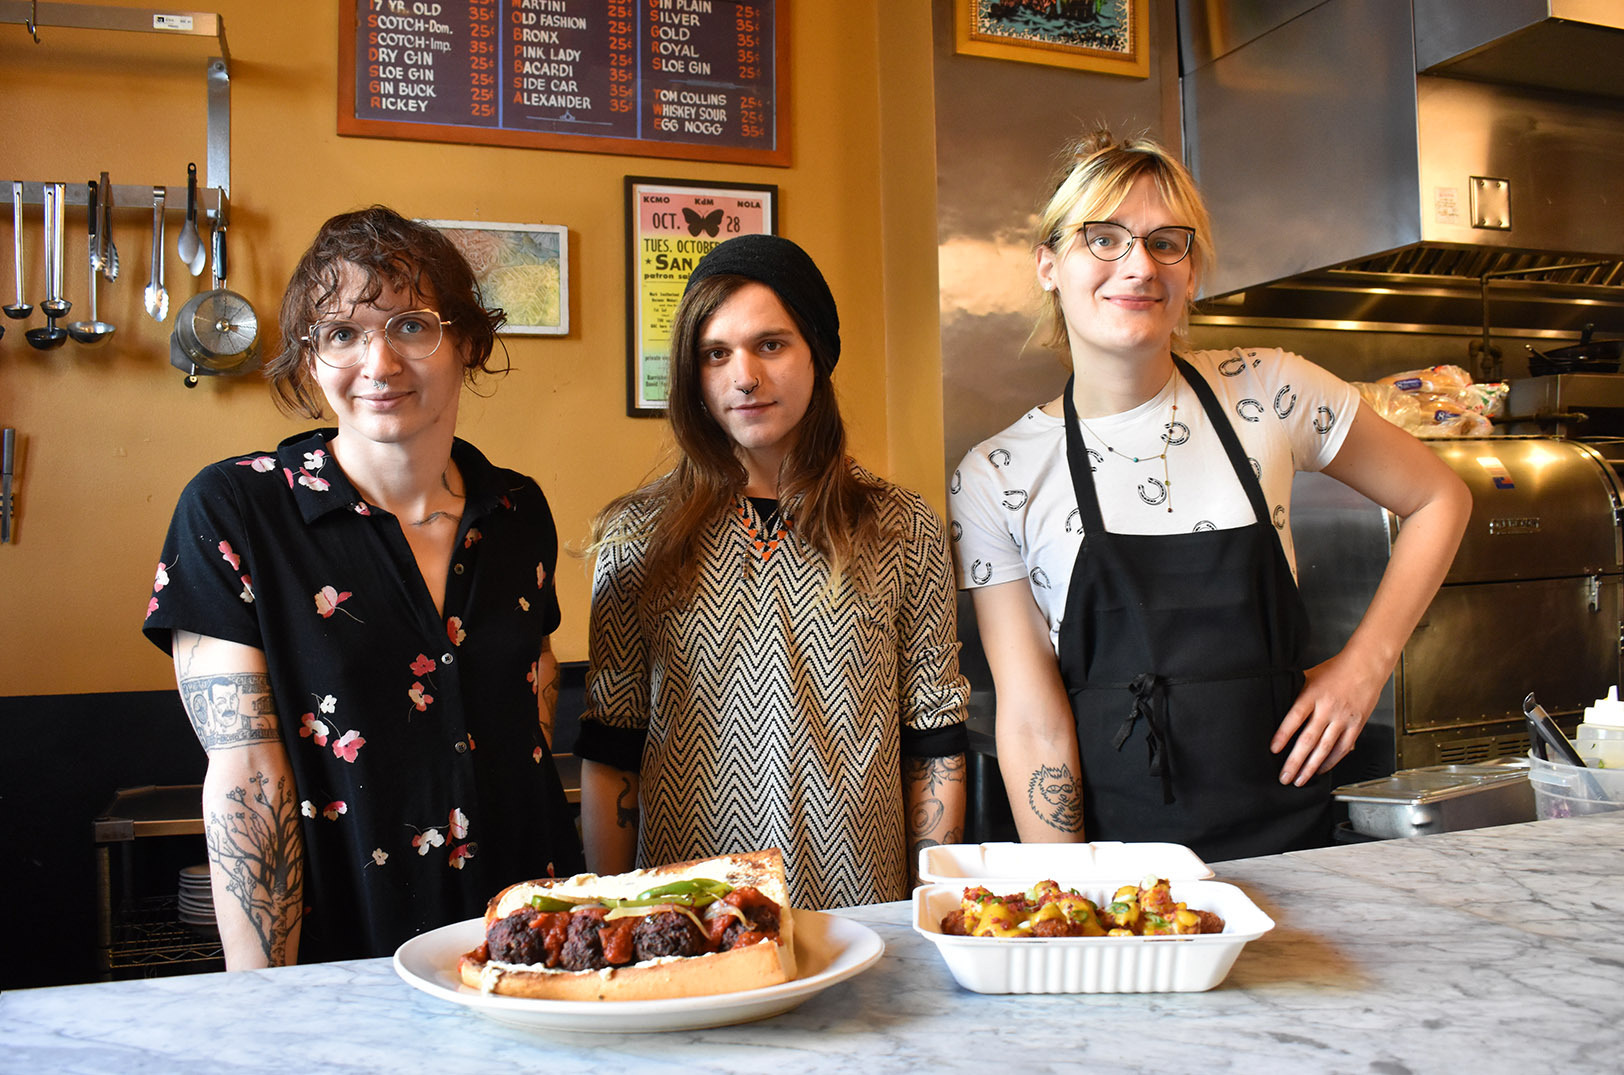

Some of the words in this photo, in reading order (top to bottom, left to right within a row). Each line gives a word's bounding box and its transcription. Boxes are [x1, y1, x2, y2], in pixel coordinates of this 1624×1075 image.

[413, 2, 442, 16] OLD
[511, 0, 566, 12] MARTINI
[677, 0, 712, 14] PLAIN
[511, 10, 536, 25] OLD
[540, 14, 587, 30] FASHION
[650, 9, 700, 27] SILVER
[513, 27, 559, 44] BRONX
[650, 25, 690, 41] GOLD
[368, 47, 398, 63] DRY
[403, 51, 433, 66] GIN
[514, 44, 546, 59] PINK
[550, 48, 581, 62] LADY
[651, 41, 700, 58] ROYAL
[369, 65, 403, 79] SLOE
[408, 68, 434, 81] GIN
[514, 60, 573, 77] BACARDI
[652, 57, 685, 73] SLOE
[688, 60, 711, 75] GIN
[369, 80, 394, 94] GIN
[399, 82, 437, 97] BUCK
[513, 77, 545, 90] SIDE
[550, 80, 578, 92] CAR
[370, 97, 428, 112] RICKEY
[513, 91, 591, 110] ALEXANDER
[653, 89, 678, 102] TOM
[680, 91, 727, 106] COLLINS
[653, 103, 697, 119] WHISKEY
[699, 107, 727, 122] SOUR
[654, 118, 679, 132] EGG
[684, 121, 723, 135] NOGG
[643, 196, 670, 204] KCMO
[737, 201, 761, 209] NOLA
[652, 212, 681, 230] OCT.
[726, 216, 741, 233] 28
[643, 238, 672, 253] TUES.
